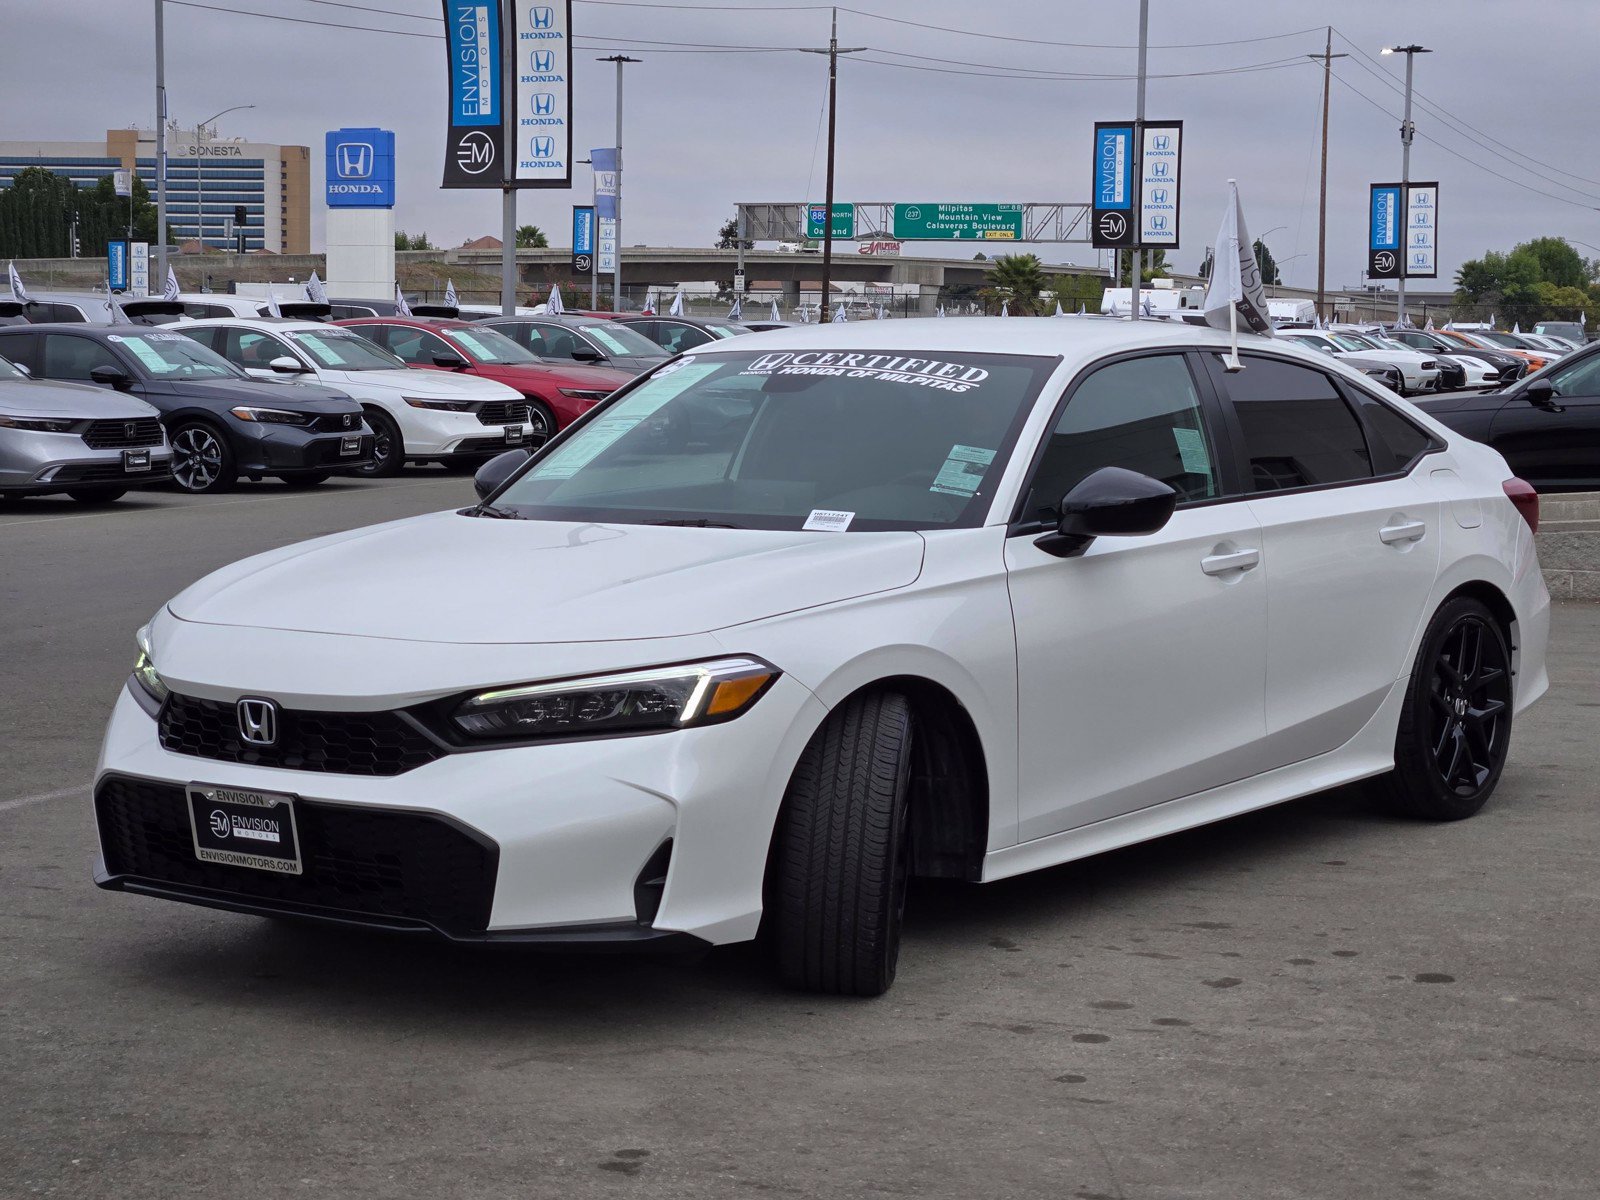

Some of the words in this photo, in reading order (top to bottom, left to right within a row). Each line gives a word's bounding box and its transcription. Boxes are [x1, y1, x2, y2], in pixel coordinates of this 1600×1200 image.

[458, 6, 477, 116] ENVISION
[479, 16, 488, 106] MOTORS
[189, 146, 242, 156] SONESTA
[1102, 134, 1115, 202] ENVISION
[328, 184, 383, 193] HONDA
[1377, 193, 1386, 244] ENVISION
[778, 367, 842, 377] HONDA
[847, 369, 876, 378] OF
[874, 372, 971, 393] MILPITAS
[793, 352, 989, 383] CERTIFIED
[216, 790, 264, 805] ENVISION
[232, 815, 279, 832] ENVISION
[200, 850, 298, 872] ENVISIONMOTORS.COM
